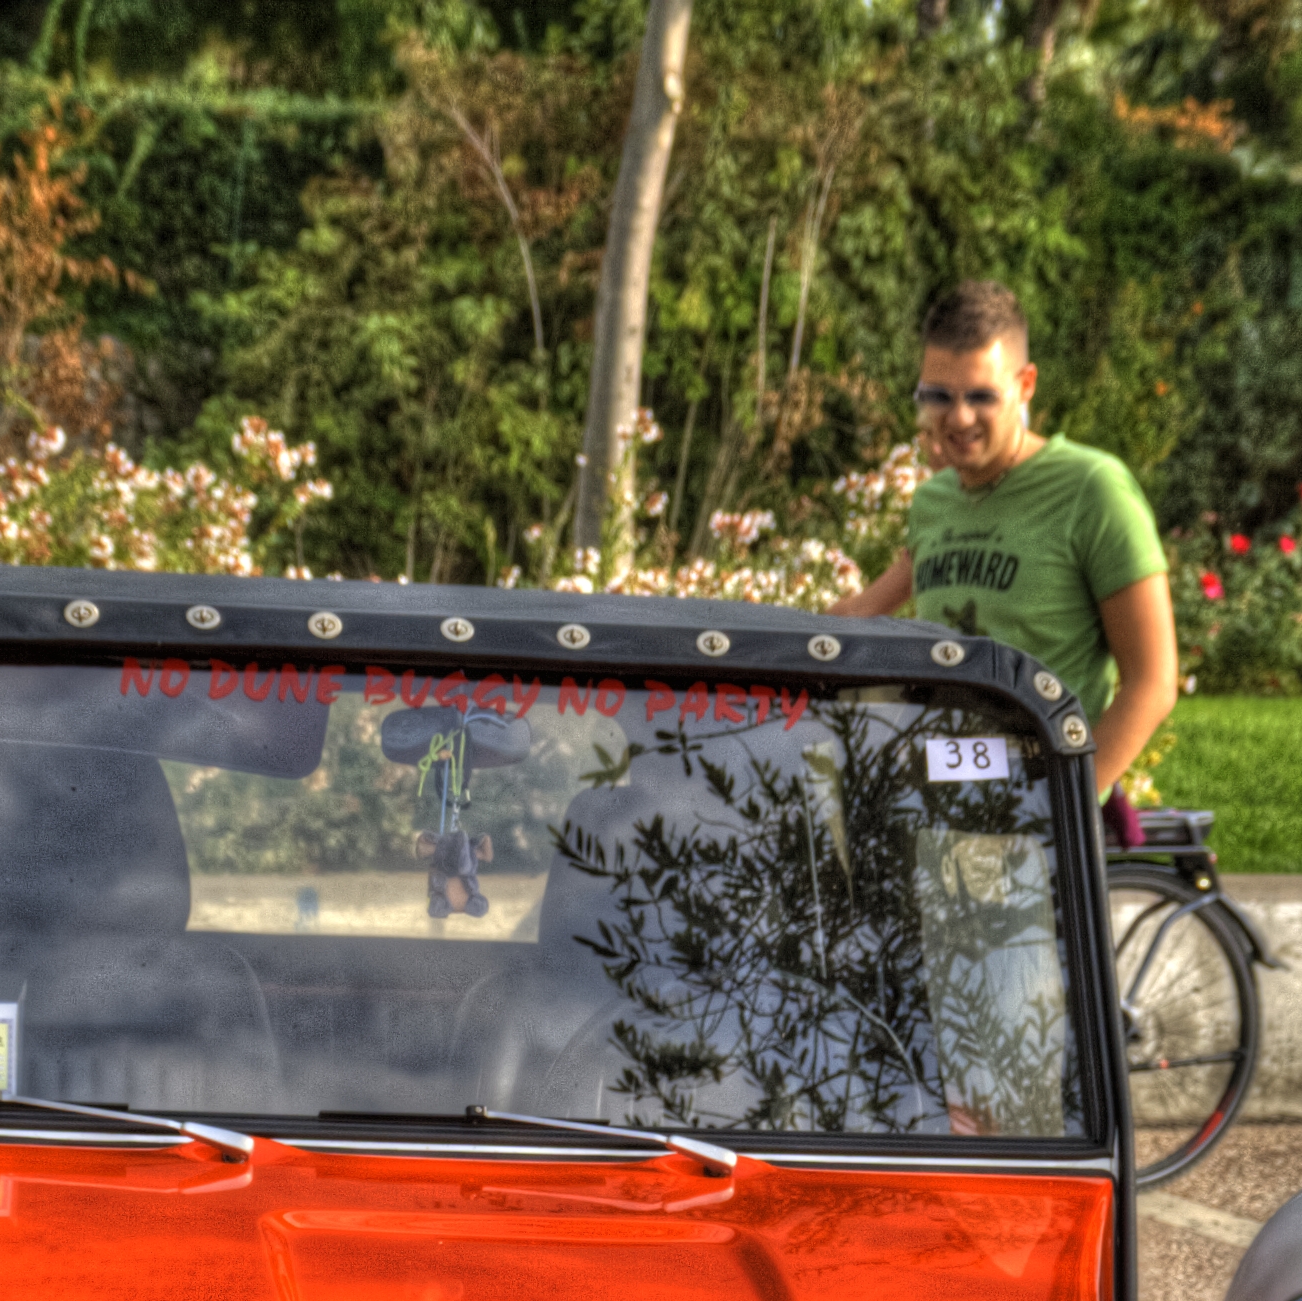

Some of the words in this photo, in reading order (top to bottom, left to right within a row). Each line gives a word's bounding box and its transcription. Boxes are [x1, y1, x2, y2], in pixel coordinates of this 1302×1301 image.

[120, 656, 191, 698] NO
[208, 658, 346, 705] DUNE
[364, 665, 541, 719] BUGGY
[558, 676, 626, 717] NO
[644, 680, 809, 731] PARTY
[945, 741, 991, 769] 38
